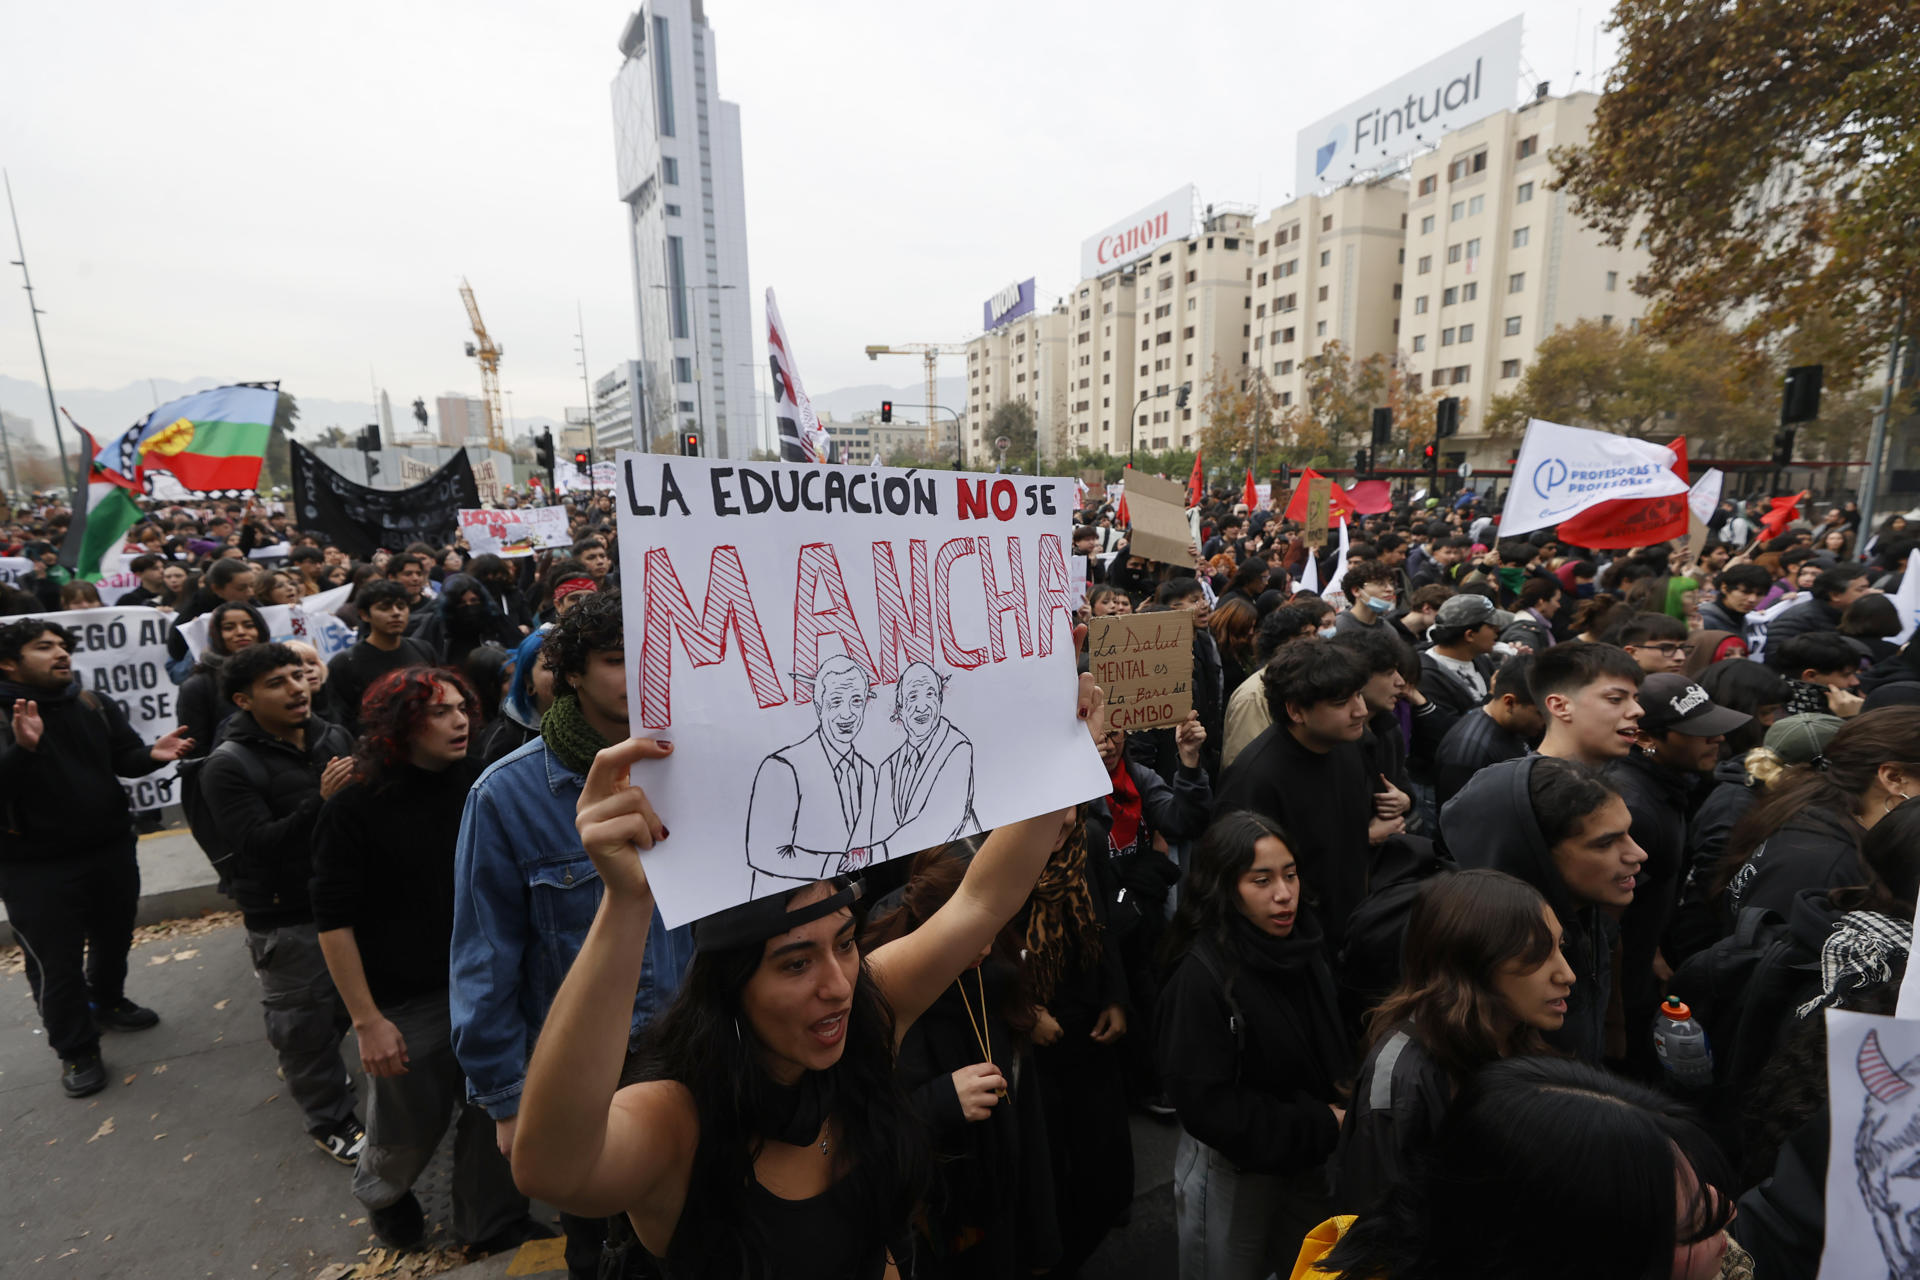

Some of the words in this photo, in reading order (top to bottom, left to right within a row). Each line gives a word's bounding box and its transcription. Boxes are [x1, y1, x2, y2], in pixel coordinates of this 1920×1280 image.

[1354, 56, 1483, 155] Fintual
[1097, 210, 1168, 264] Canon
[1654, 463, 1662, 474] Y
[624, 459, 691, 516] LA
[956, 476, 1019, 522] NO
[1024, 483, 1057, 516] SE
[641, 533, 1073, 729] MANCHA
[1094, 624, 1117, 657] La
[1096, 659, 1149, 683] MENTAL
[141, 693, 172, 721] SE
[1107, 686, 1125, 705] La
[1110, 704, 1173, 728] CAMBIO
